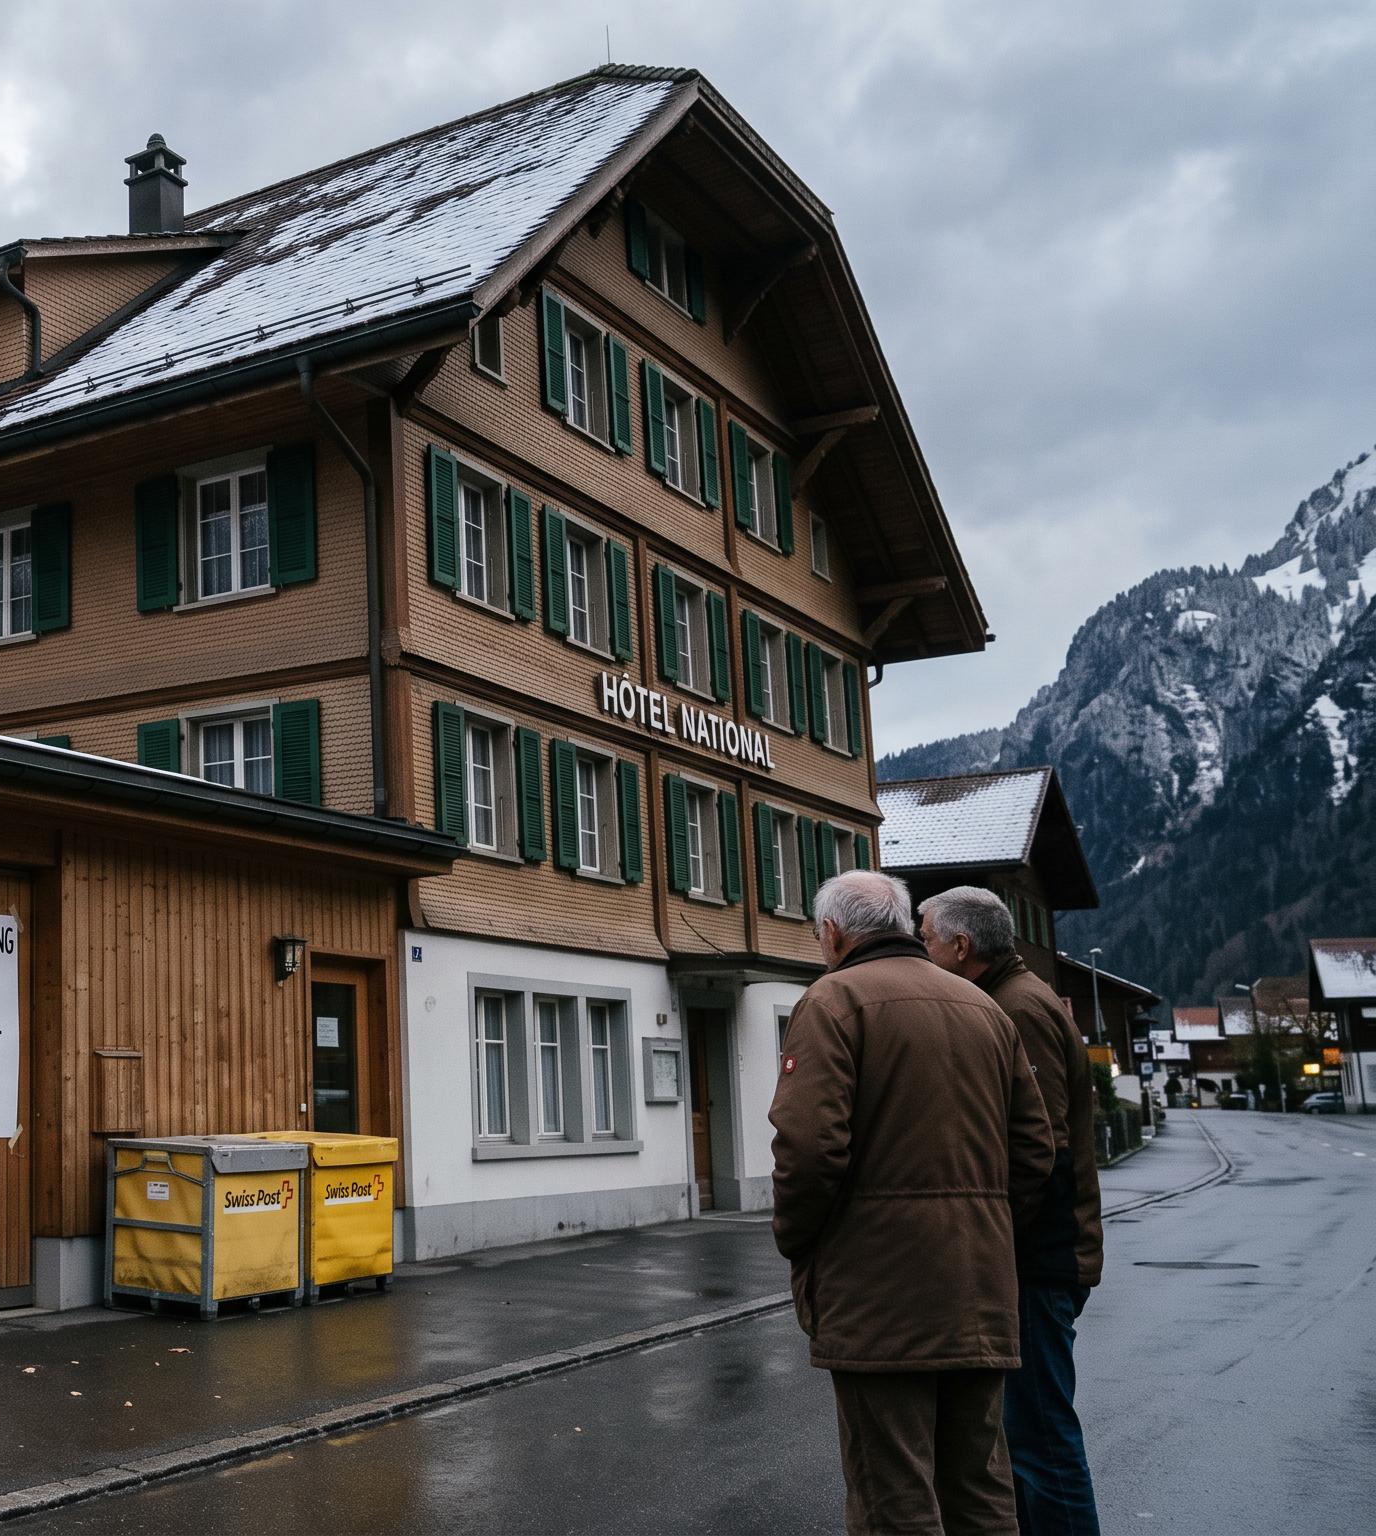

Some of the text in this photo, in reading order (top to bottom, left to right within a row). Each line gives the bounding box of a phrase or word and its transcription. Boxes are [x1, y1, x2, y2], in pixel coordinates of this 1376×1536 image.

[681, 703, 775, 769] NATIONAL
[224, 1188, 281, 1209] Swiss Post
[325, 1181, 372, 1200] Swiss Post
